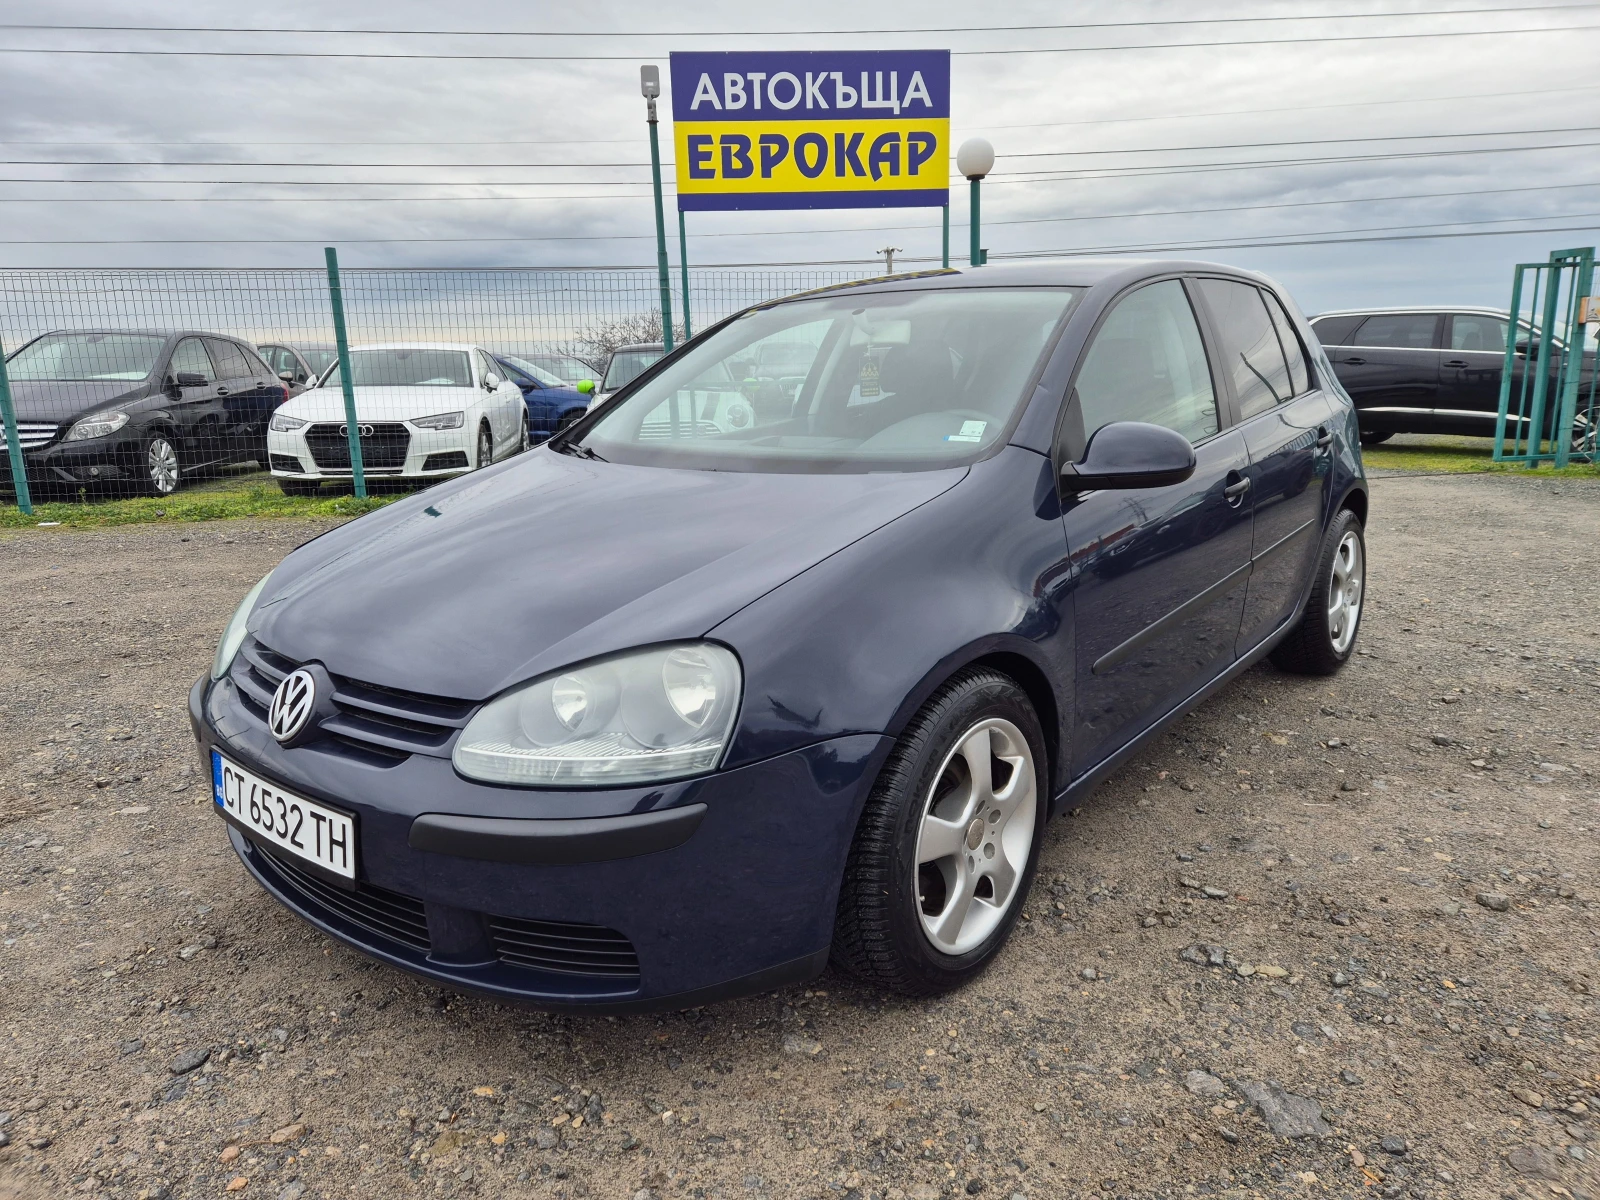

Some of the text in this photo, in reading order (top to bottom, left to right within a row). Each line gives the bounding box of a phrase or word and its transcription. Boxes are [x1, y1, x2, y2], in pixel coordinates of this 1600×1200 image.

[690, 70, 933, 115] АВТОКЪЩА
[687, 131, 937, 182] ЕВРОКАР
[269, 671, 314, 741] VW
[223, 766, 347, 869] CT 6532 TH
